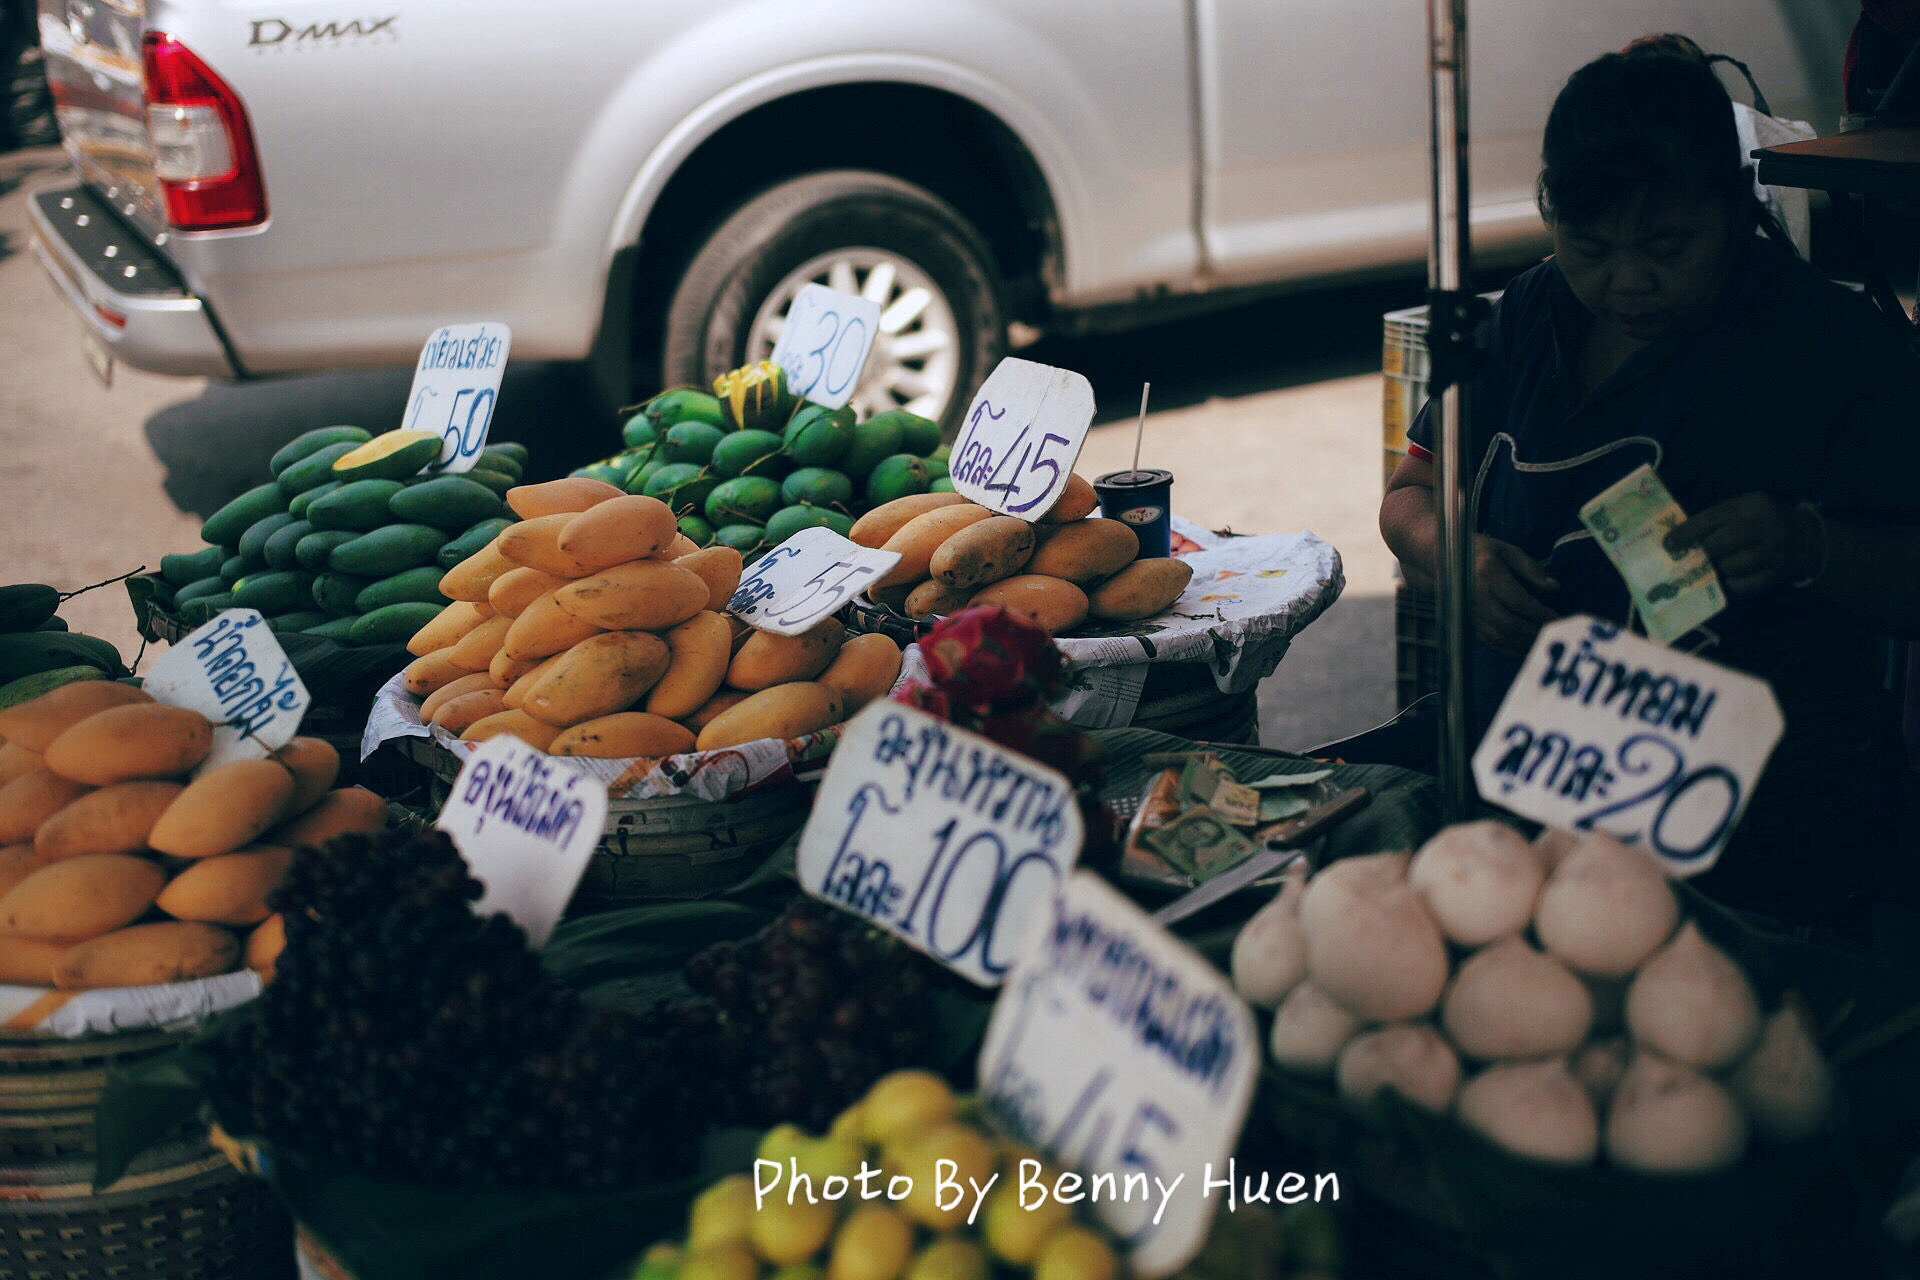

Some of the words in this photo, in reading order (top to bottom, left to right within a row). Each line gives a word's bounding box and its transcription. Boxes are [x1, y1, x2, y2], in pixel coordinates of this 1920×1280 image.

[797, 310, 866, 396] 30
[427, 387, 495, 471] 50
[764, 561, 876, 627] 55
